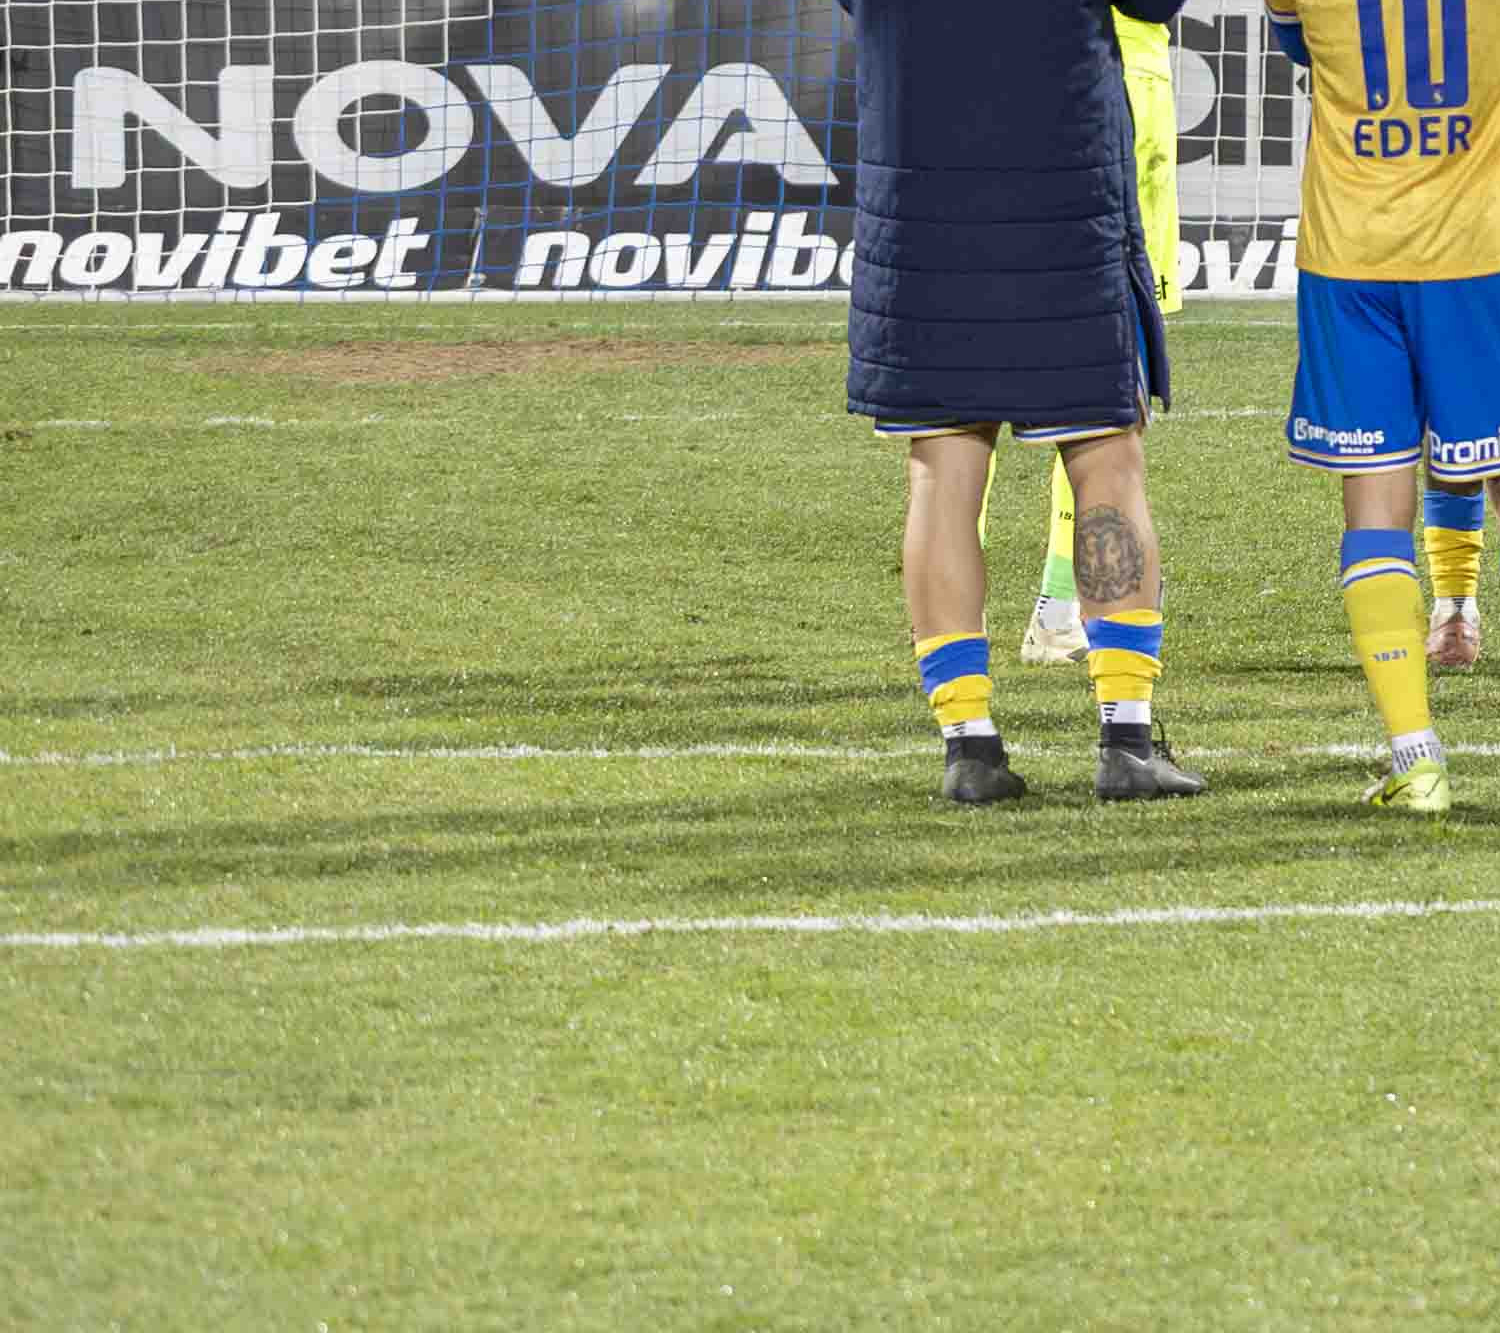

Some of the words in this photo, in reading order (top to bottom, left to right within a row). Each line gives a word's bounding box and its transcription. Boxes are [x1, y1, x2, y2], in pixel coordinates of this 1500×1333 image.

[70, 60, 839, 192] NOVA
[1354, 113, 1473, 158] EDER
[0, 211, 431, 290] novibet
[517, 211, 856, 290] novib
